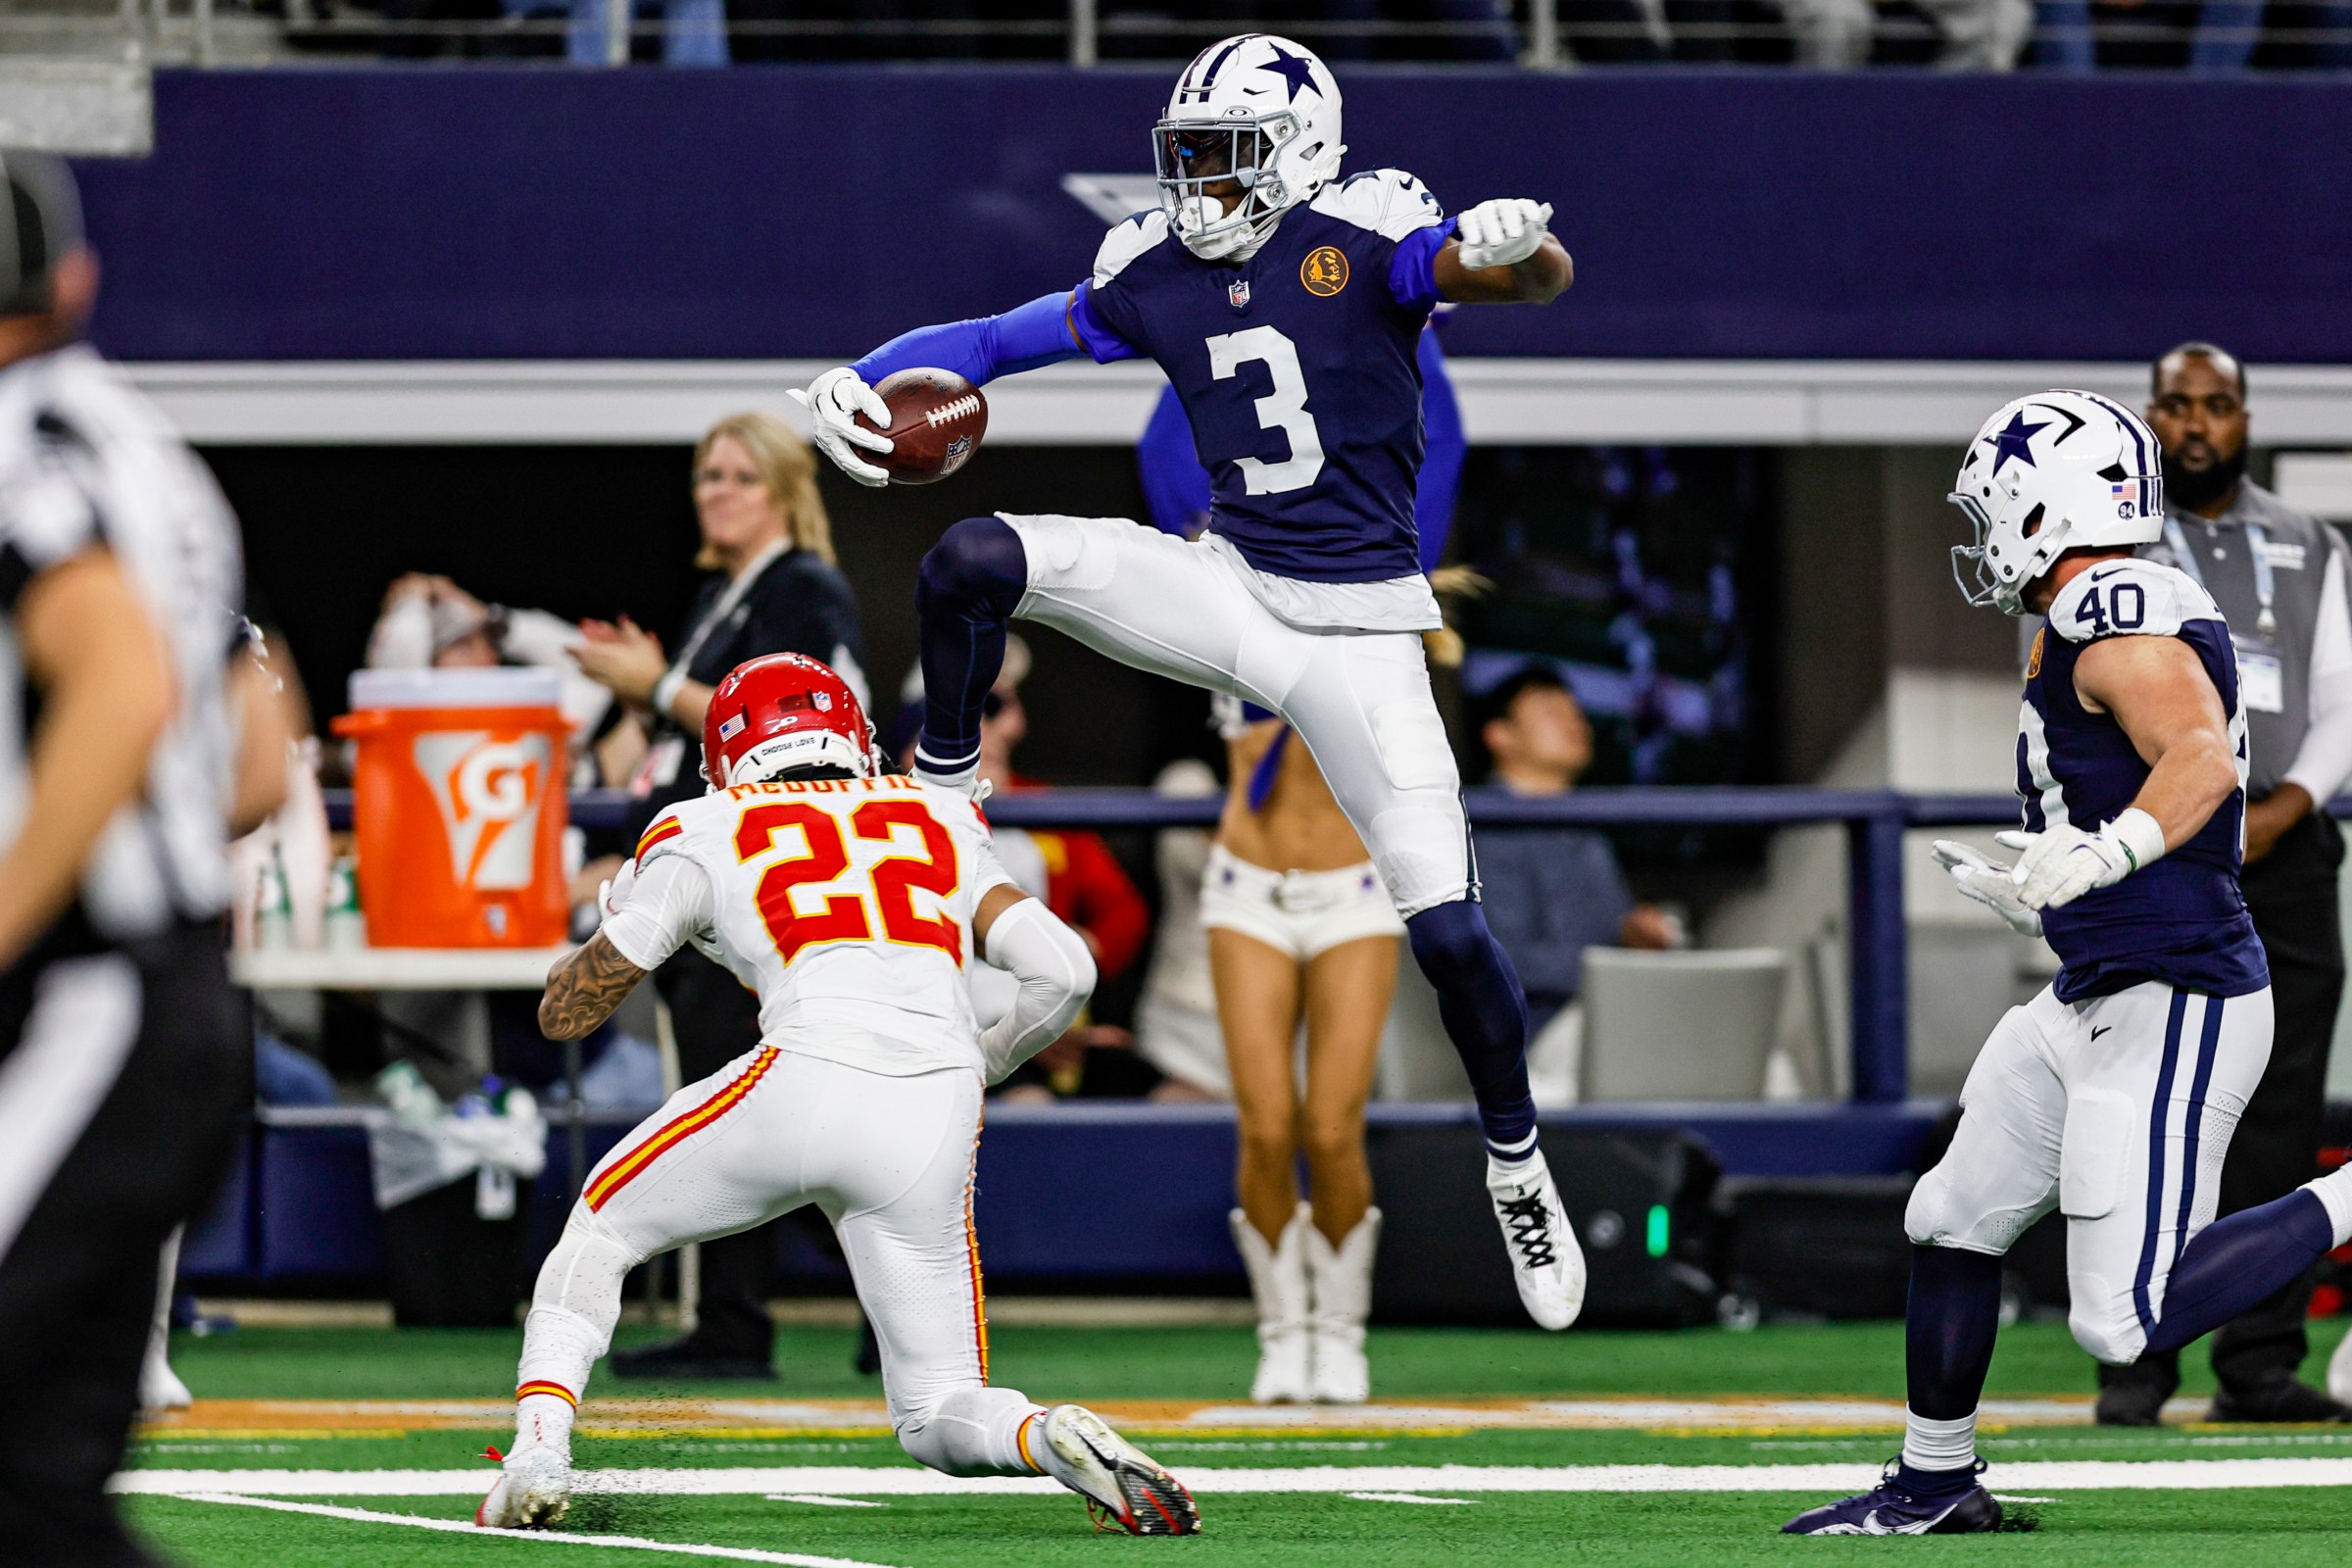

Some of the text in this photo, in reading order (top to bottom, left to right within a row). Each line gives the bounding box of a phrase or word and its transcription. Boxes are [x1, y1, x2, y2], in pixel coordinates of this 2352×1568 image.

[1205, 324, 1325, 495] 3
[2119, 504, 2133, 517] 94
[2075, 582, 2144, 633] 40
[760, 737, 815, 756] CHOOSE LOVE
[462, 746, 526, 817] G
[733, 800, 962, 971] 22
